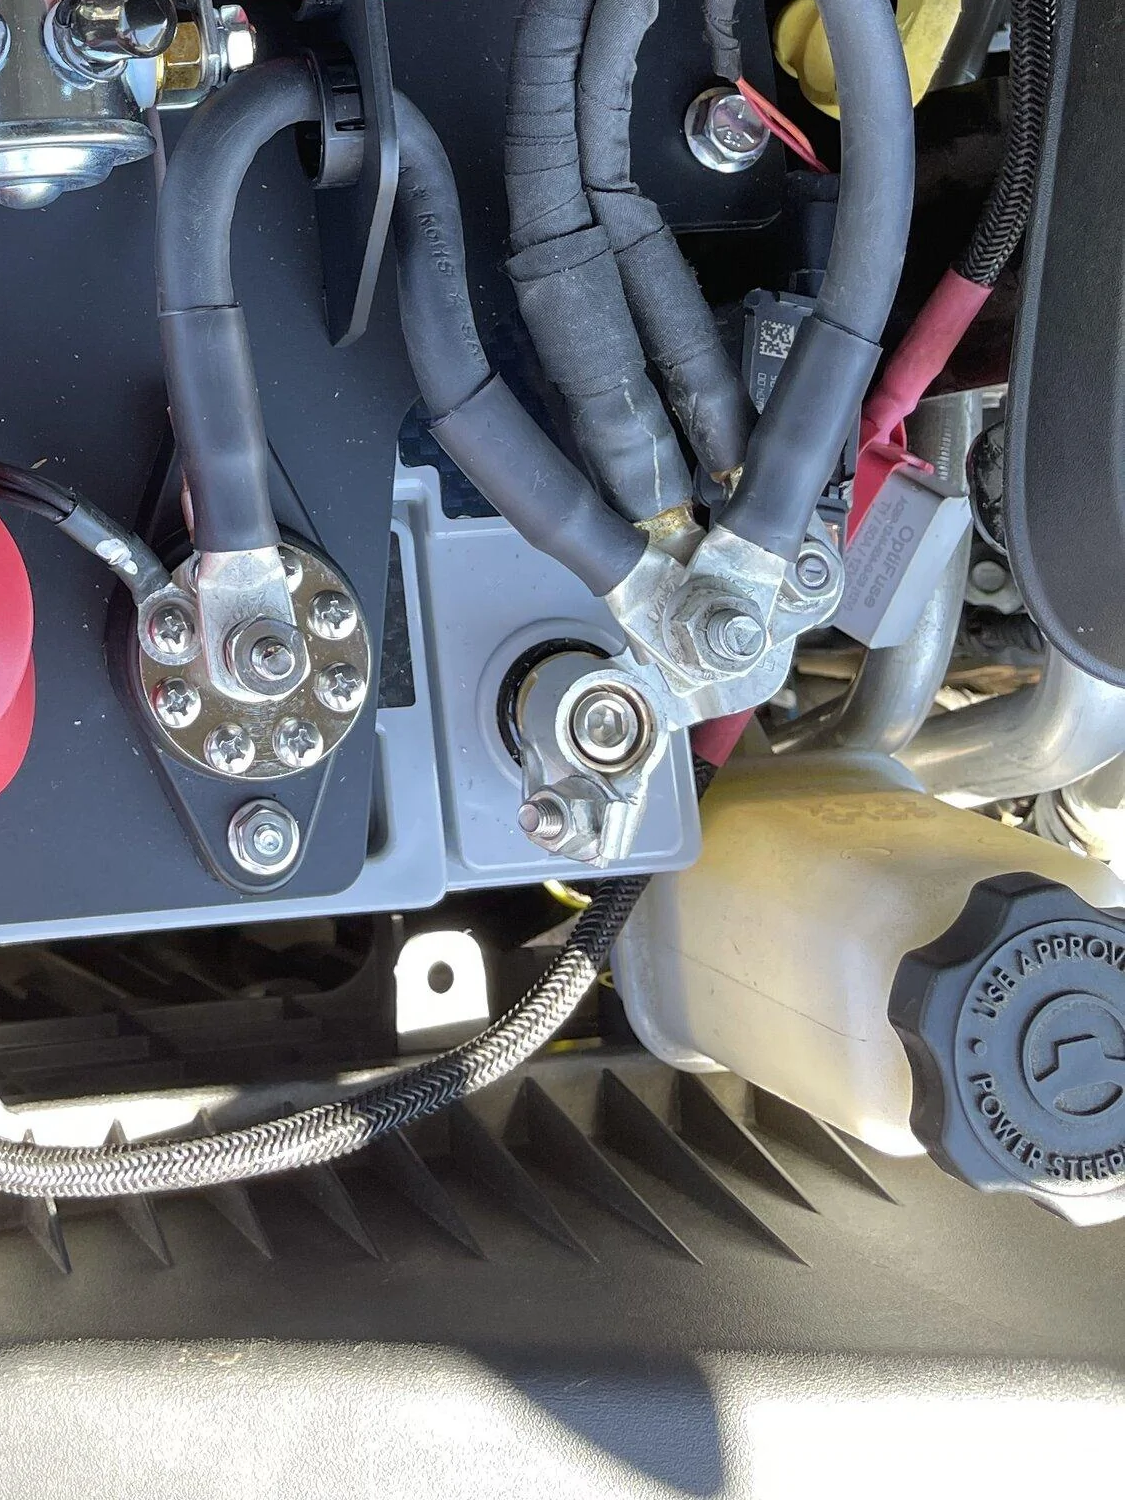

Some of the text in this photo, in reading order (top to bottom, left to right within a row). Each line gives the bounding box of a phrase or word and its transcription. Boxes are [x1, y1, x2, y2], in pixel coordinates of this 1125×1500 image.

[864, 526, 914, 607] OptiFuse
[973, 967, 1016, 1020] USE
[972, 1075, 1044, 1170] POWER
